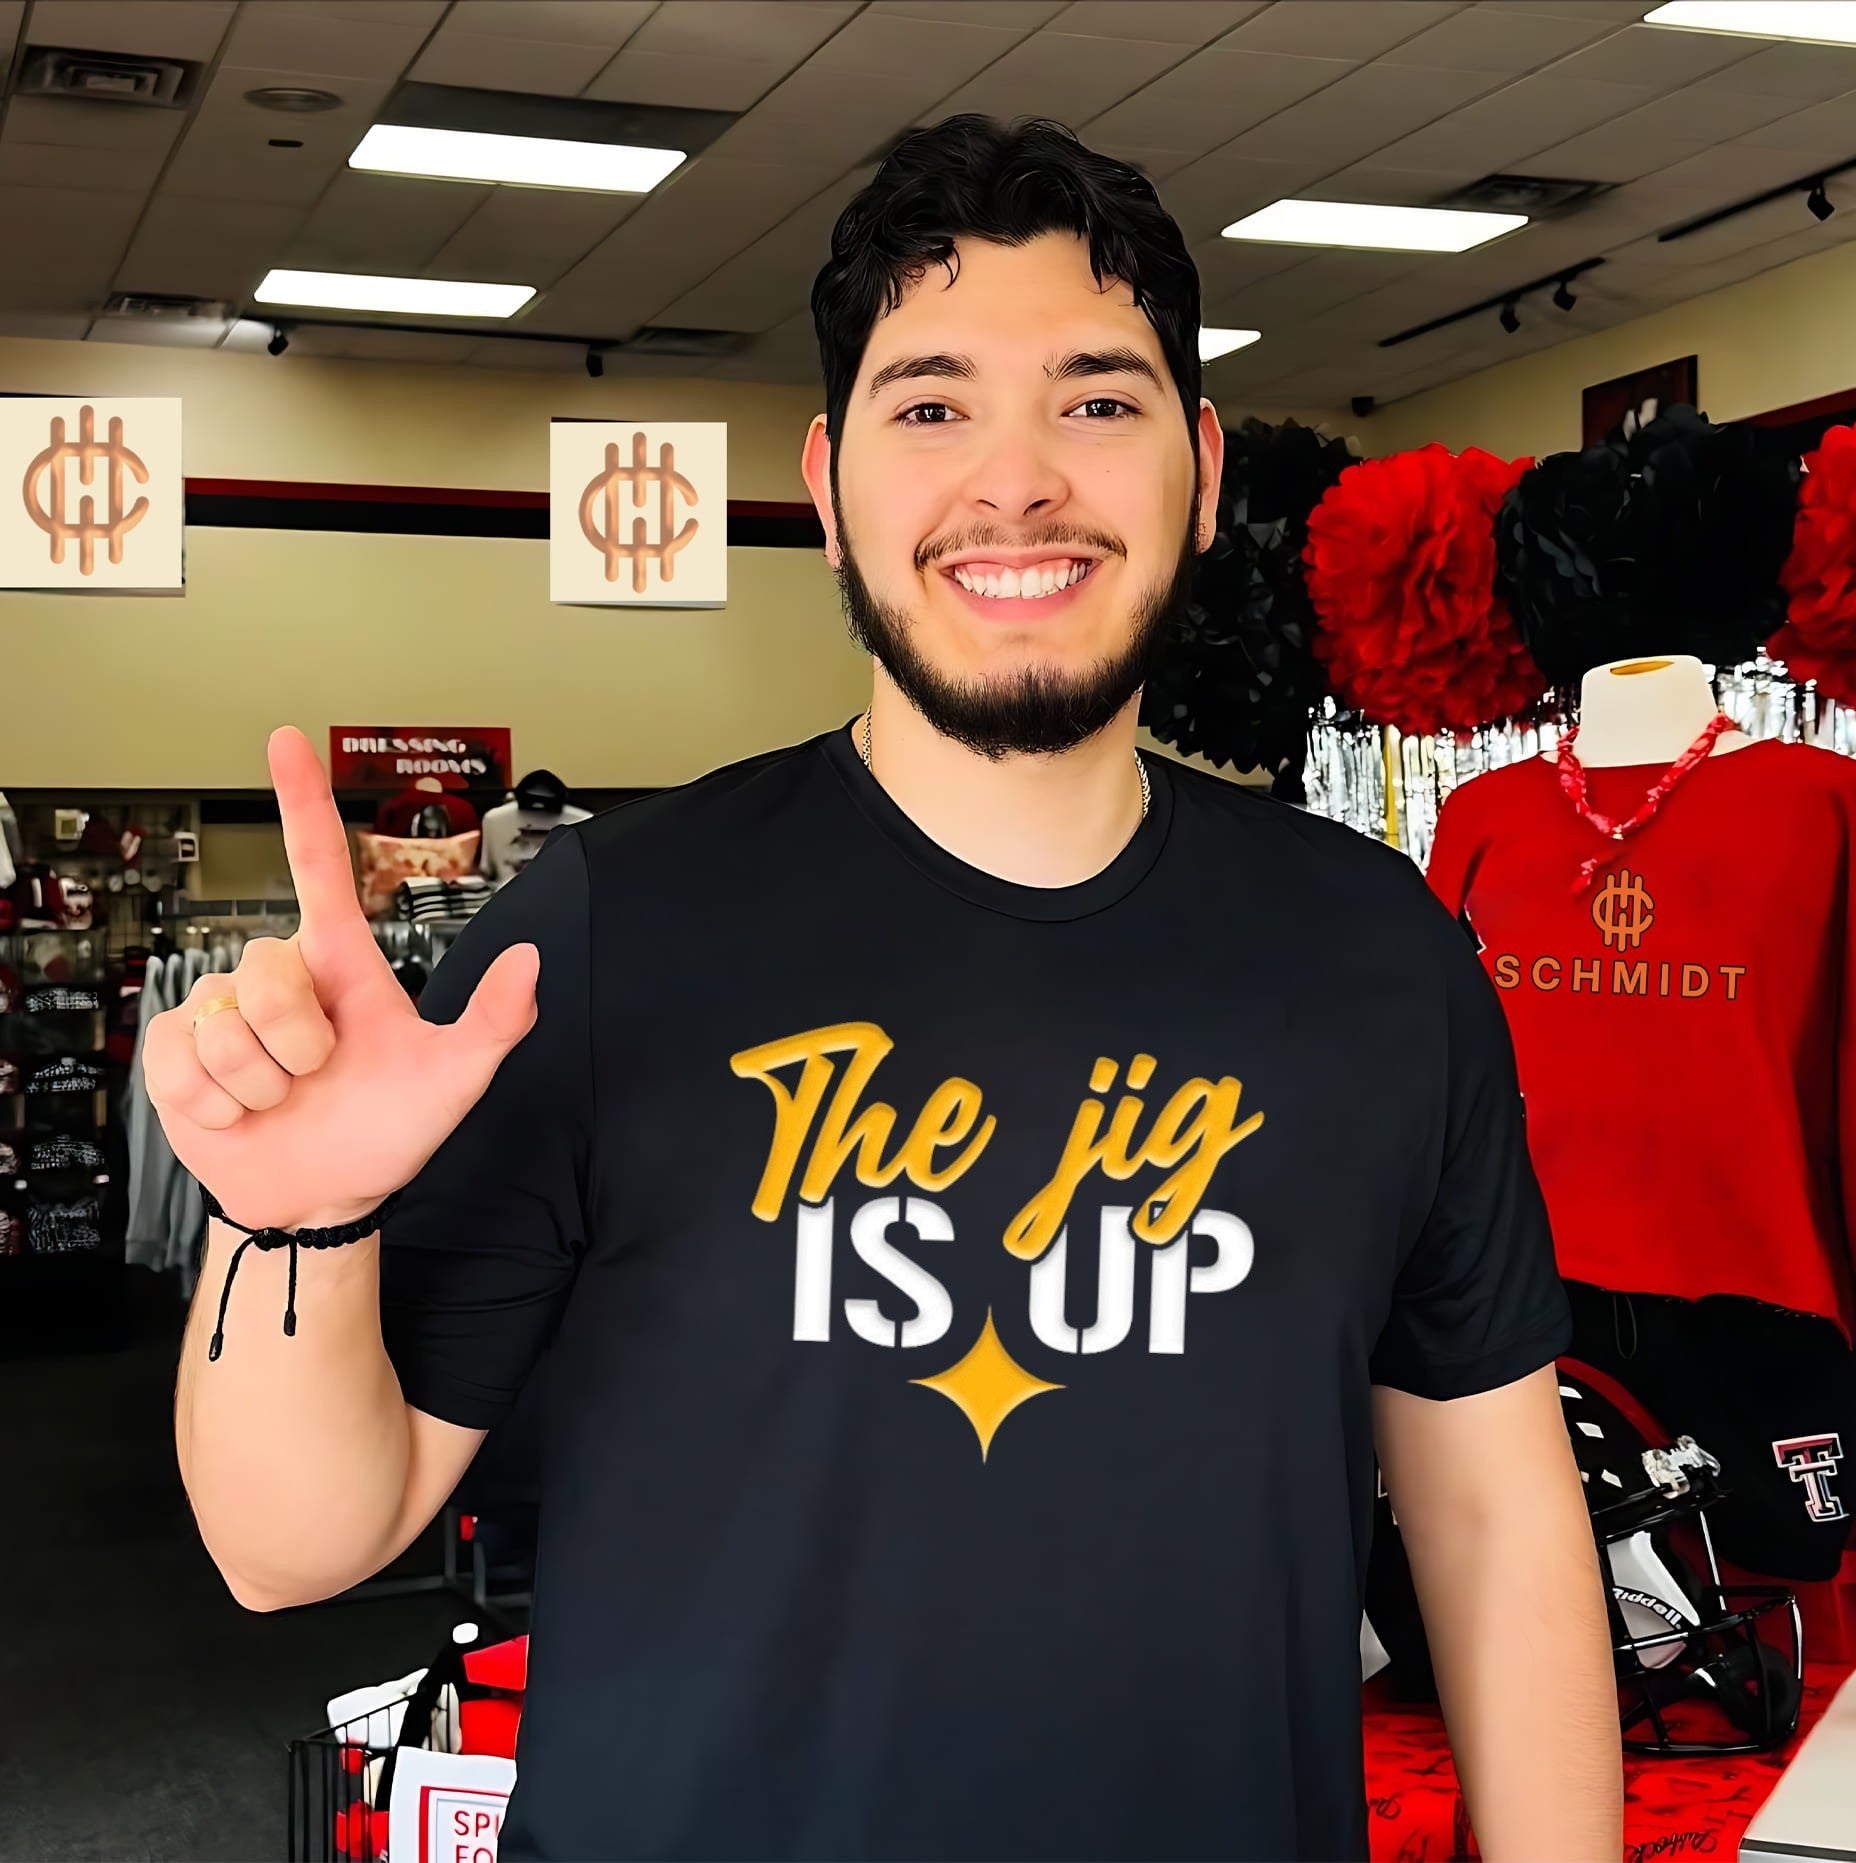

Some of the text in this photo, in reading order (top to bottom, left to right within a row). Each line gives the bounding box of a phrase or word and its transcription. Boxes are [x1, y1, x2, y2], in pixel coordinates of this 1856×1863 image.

[1494, 954, 1747, 1000] SCHMIDT
[730, 1021, 1265, 1260] The jig
[793, 1195, 1255, 1354] IS UP
